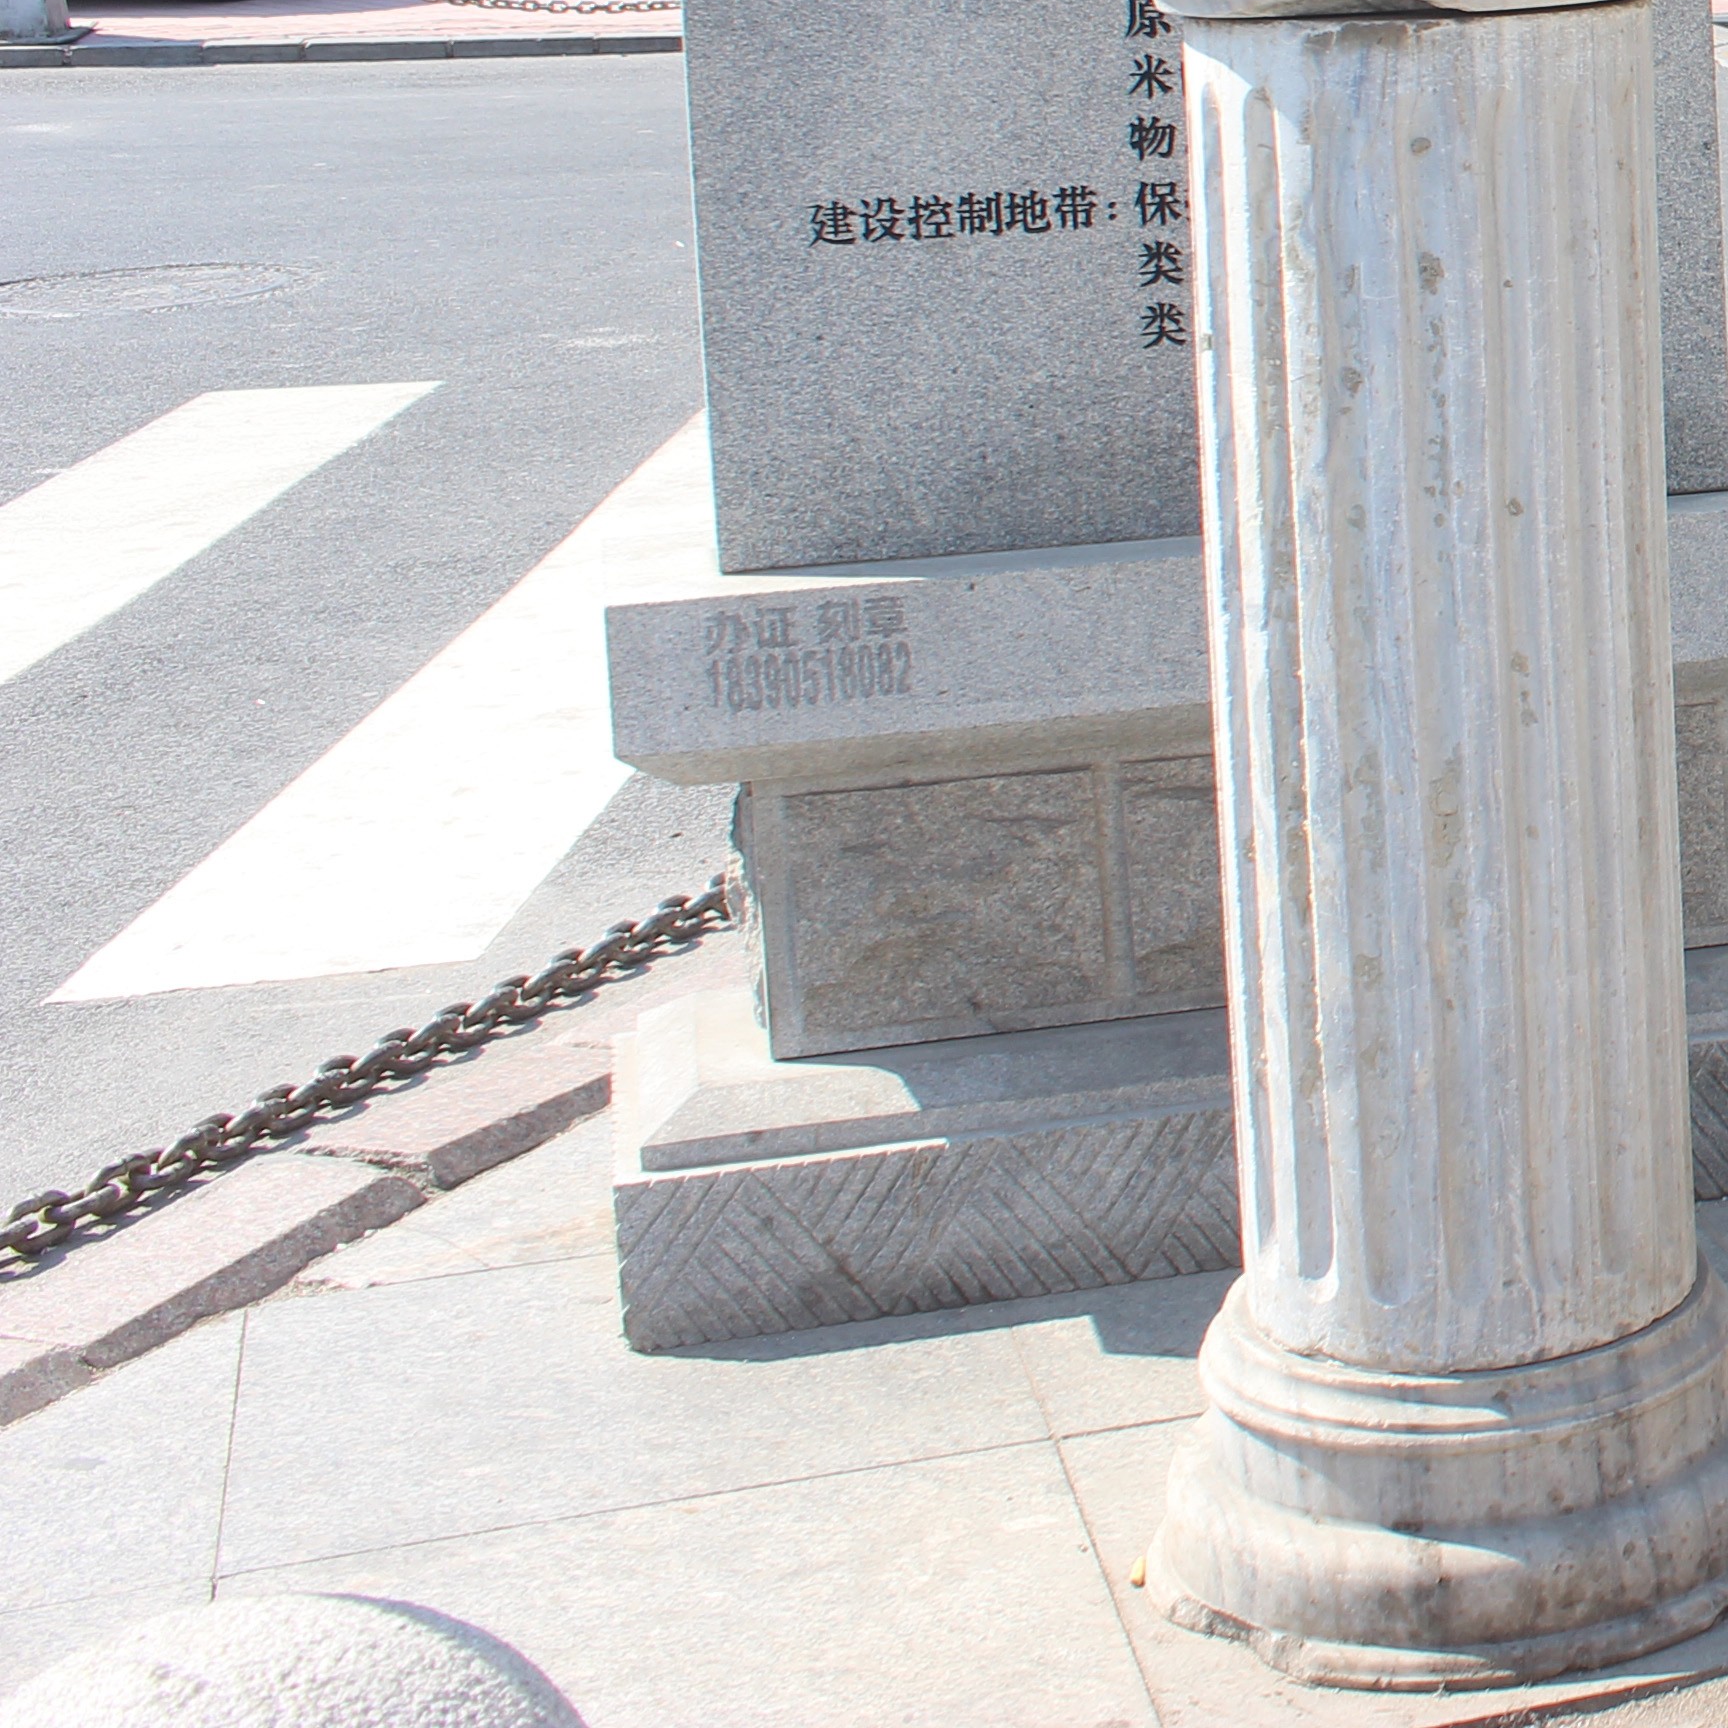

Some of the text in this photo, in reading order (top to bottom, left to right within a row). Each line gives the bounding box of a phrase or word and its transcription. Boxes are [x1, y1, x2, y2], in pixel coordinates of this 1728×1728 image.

[1128, 53, 1184, 100] 米
[703, 594, 909, 657] 办证 刻章
